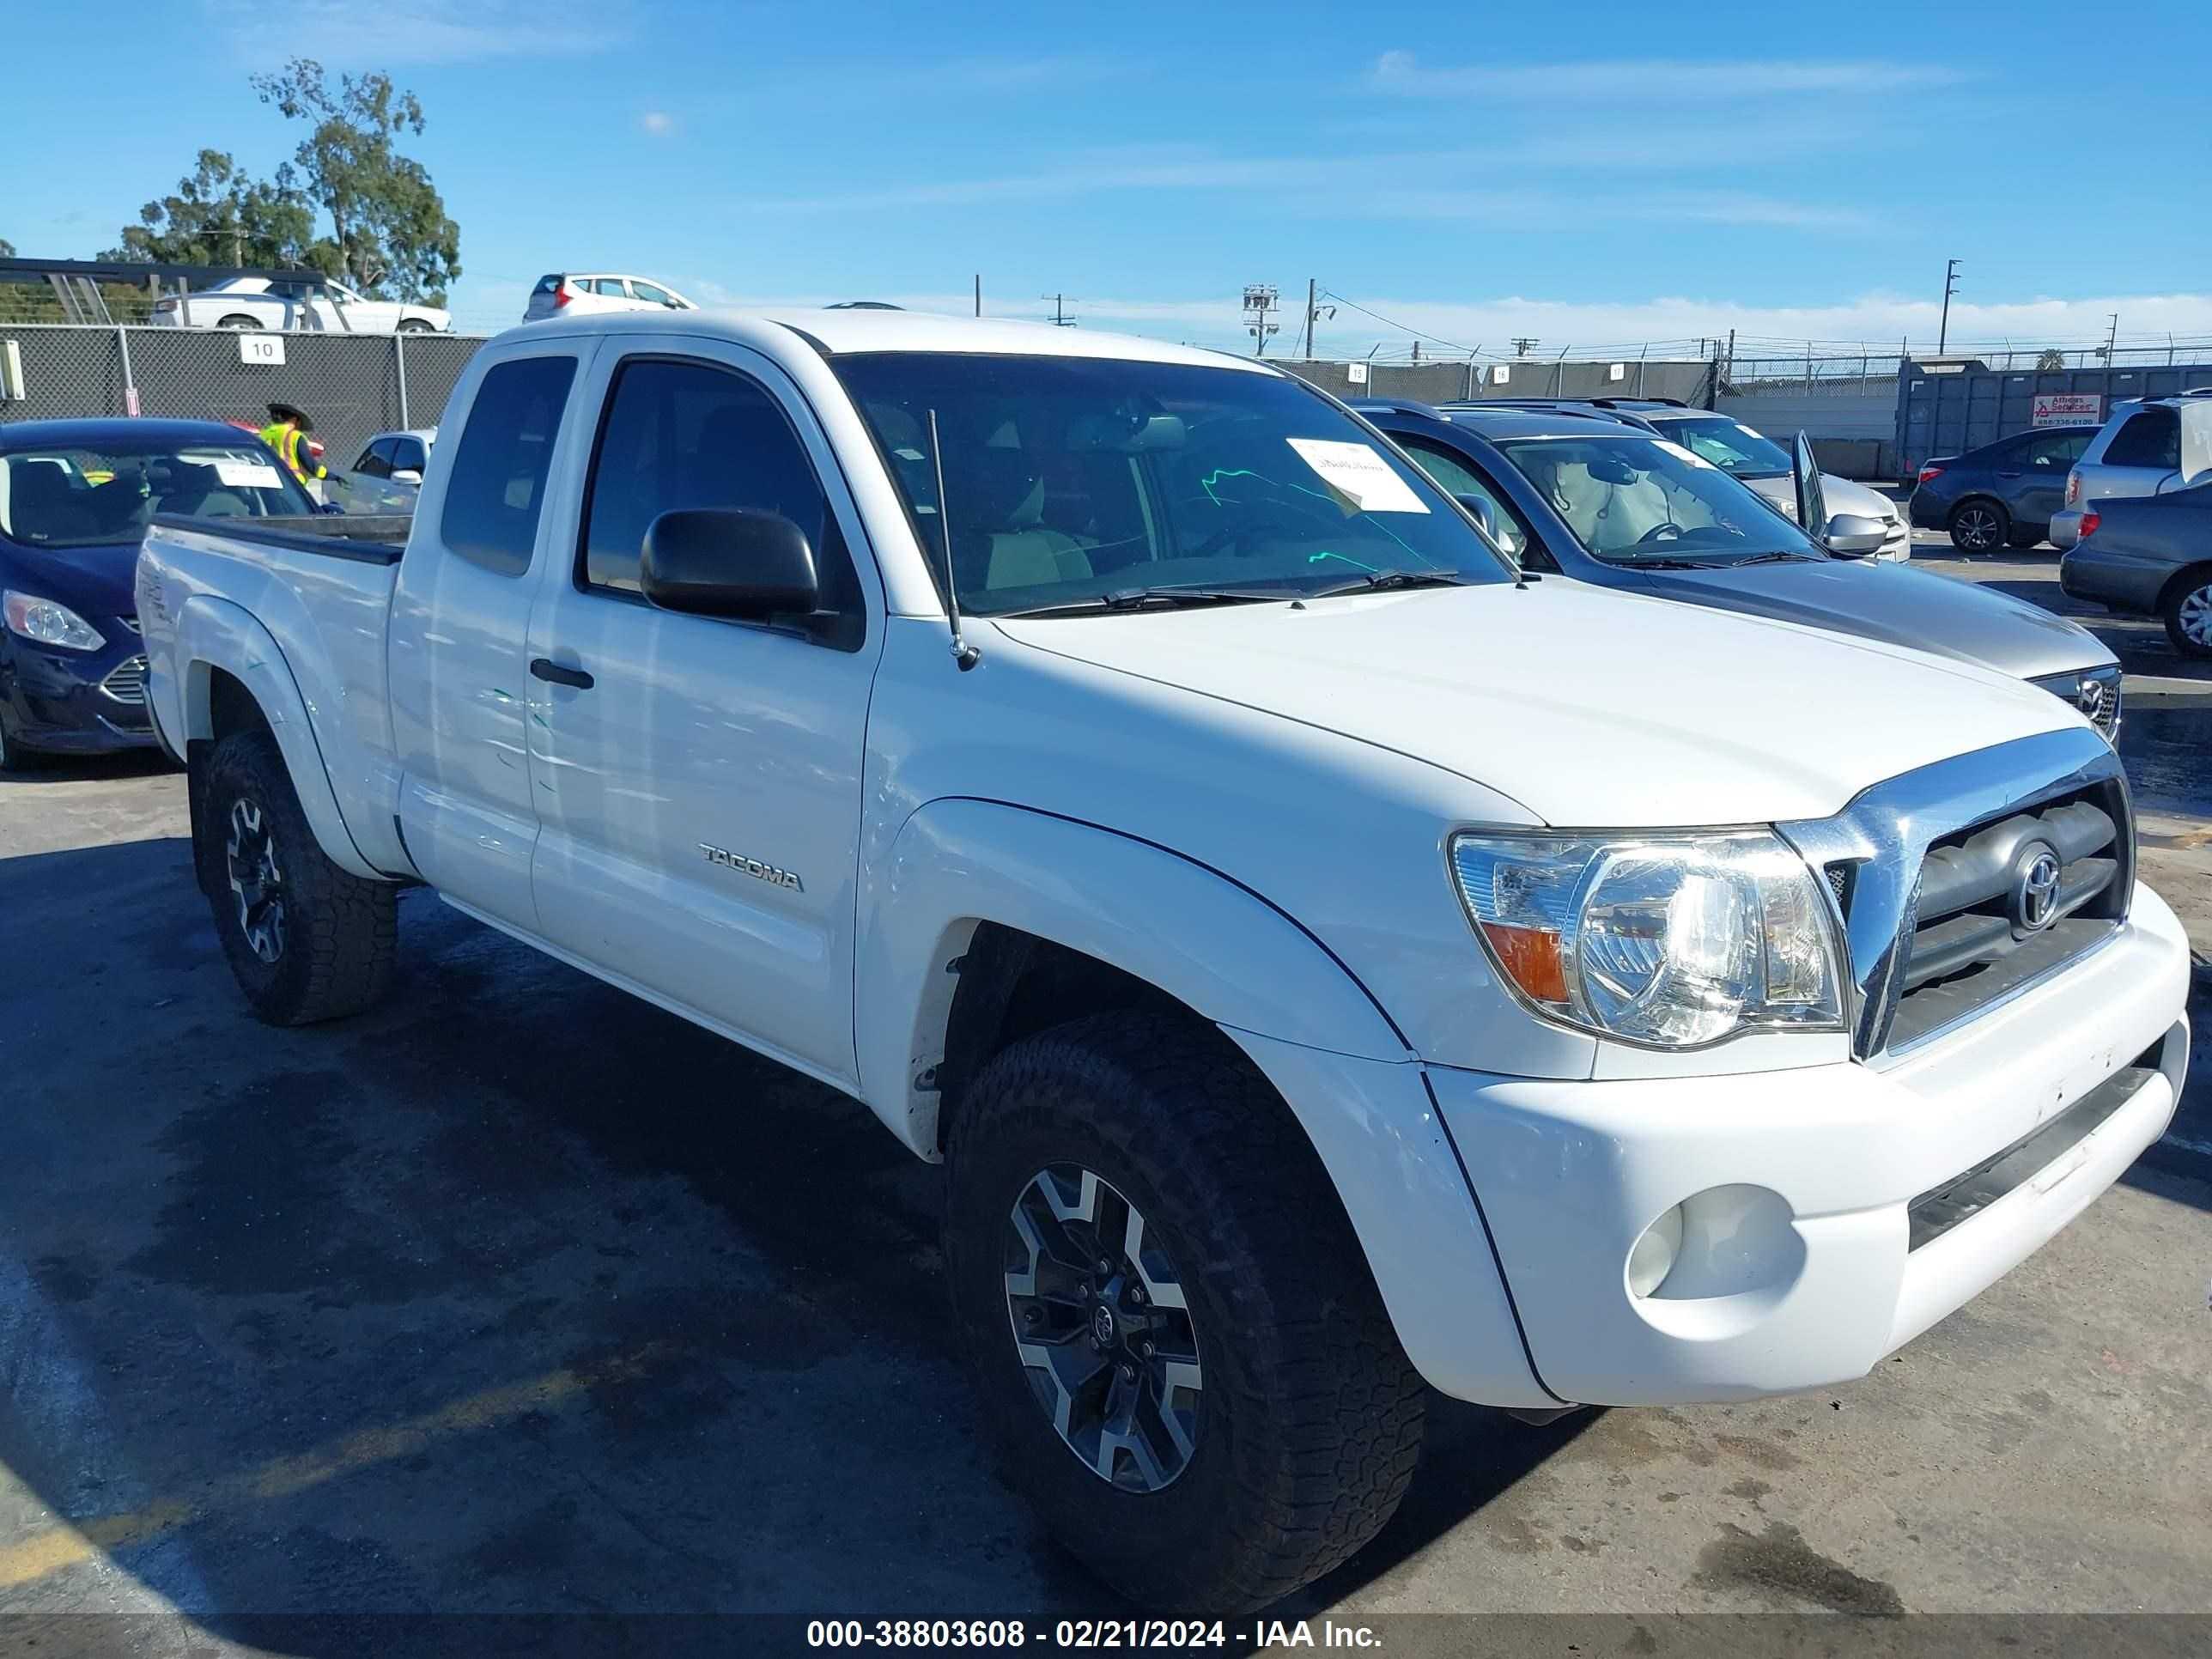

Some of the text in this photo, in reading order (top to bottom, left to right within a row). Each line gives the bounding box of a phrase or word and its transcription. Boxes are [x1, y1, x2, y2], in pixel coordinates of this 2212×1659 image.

[252, 343, 274, 357] 10
[1353, 369, 1363, 379] 15
[1498, 370, 1506, 379] 16
[699, 842, 805, 894] TACOMA
